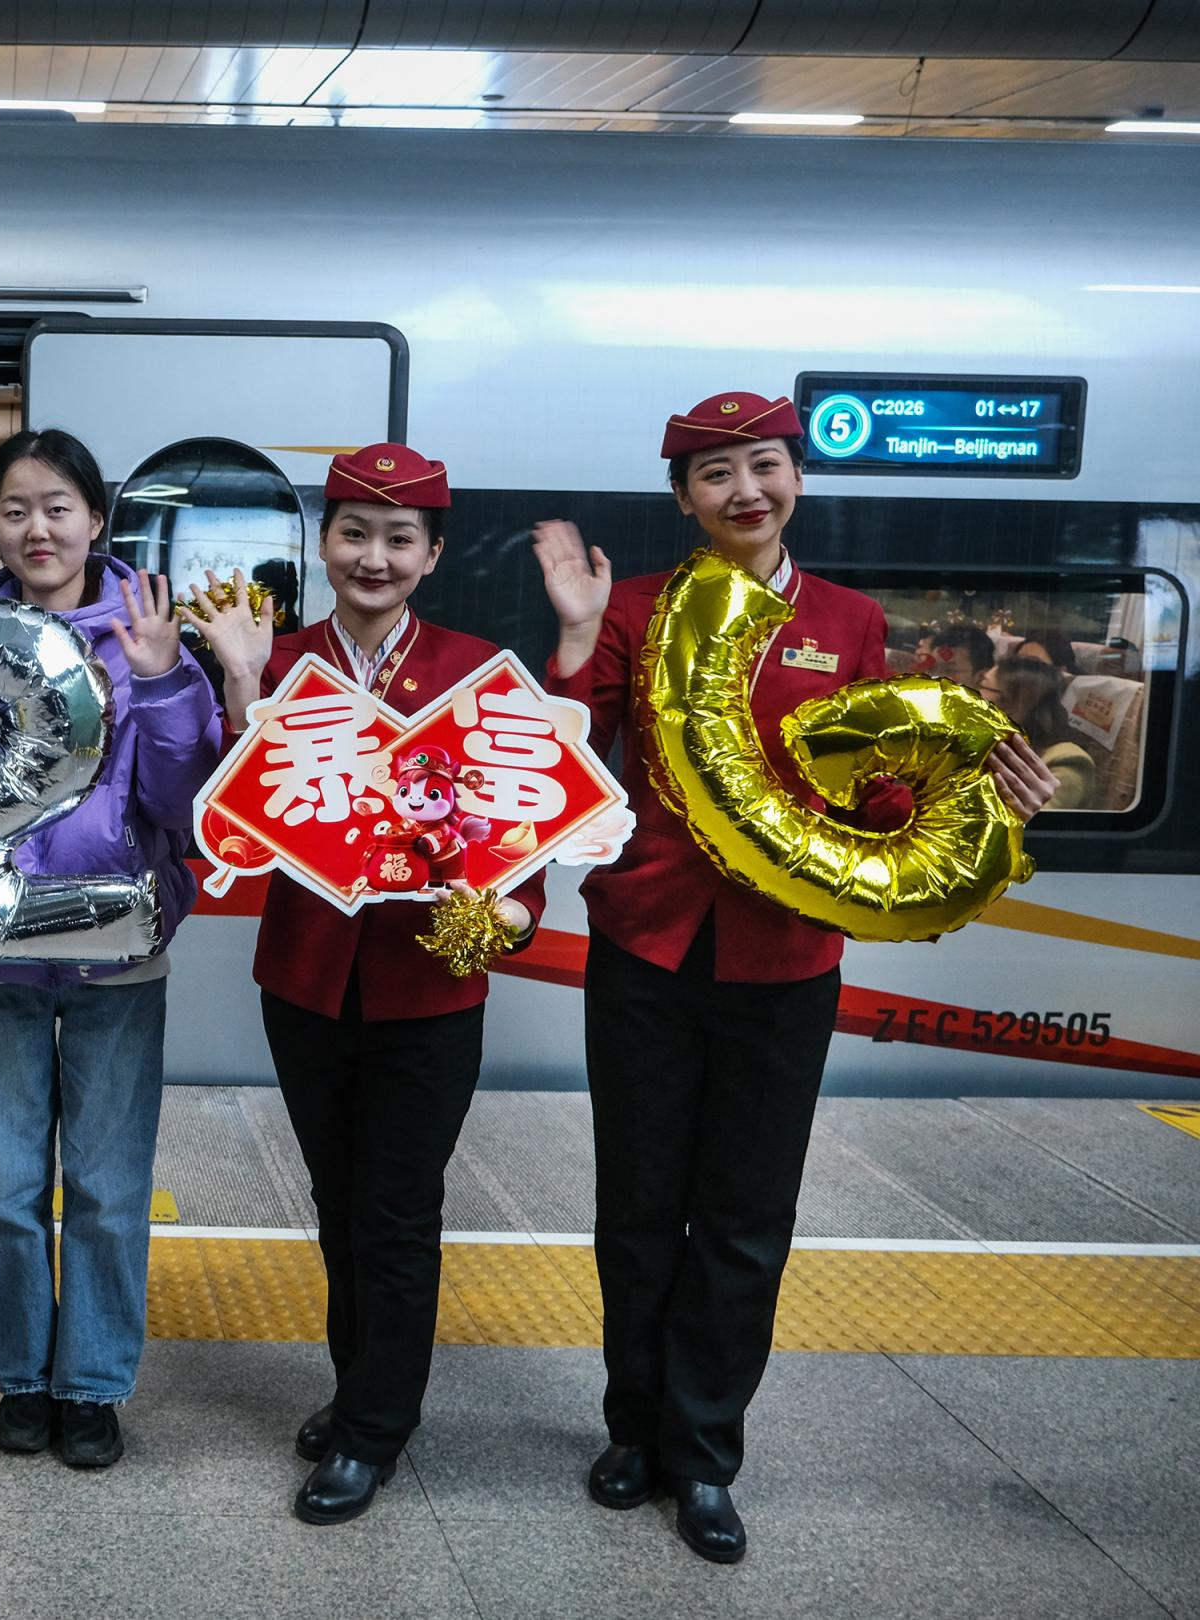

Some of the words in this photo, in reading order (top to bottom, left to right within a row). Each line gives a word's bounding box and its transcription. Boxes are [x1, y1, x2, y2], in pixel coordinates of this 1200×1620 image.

[871, 399, 925, 416] C2026
[829, 410, 851, 442] 5
[253, 687, 584, 827] 暴富
[380, 853, 412, 882] 福
[969, 1011, 1112, 1047] 529505
